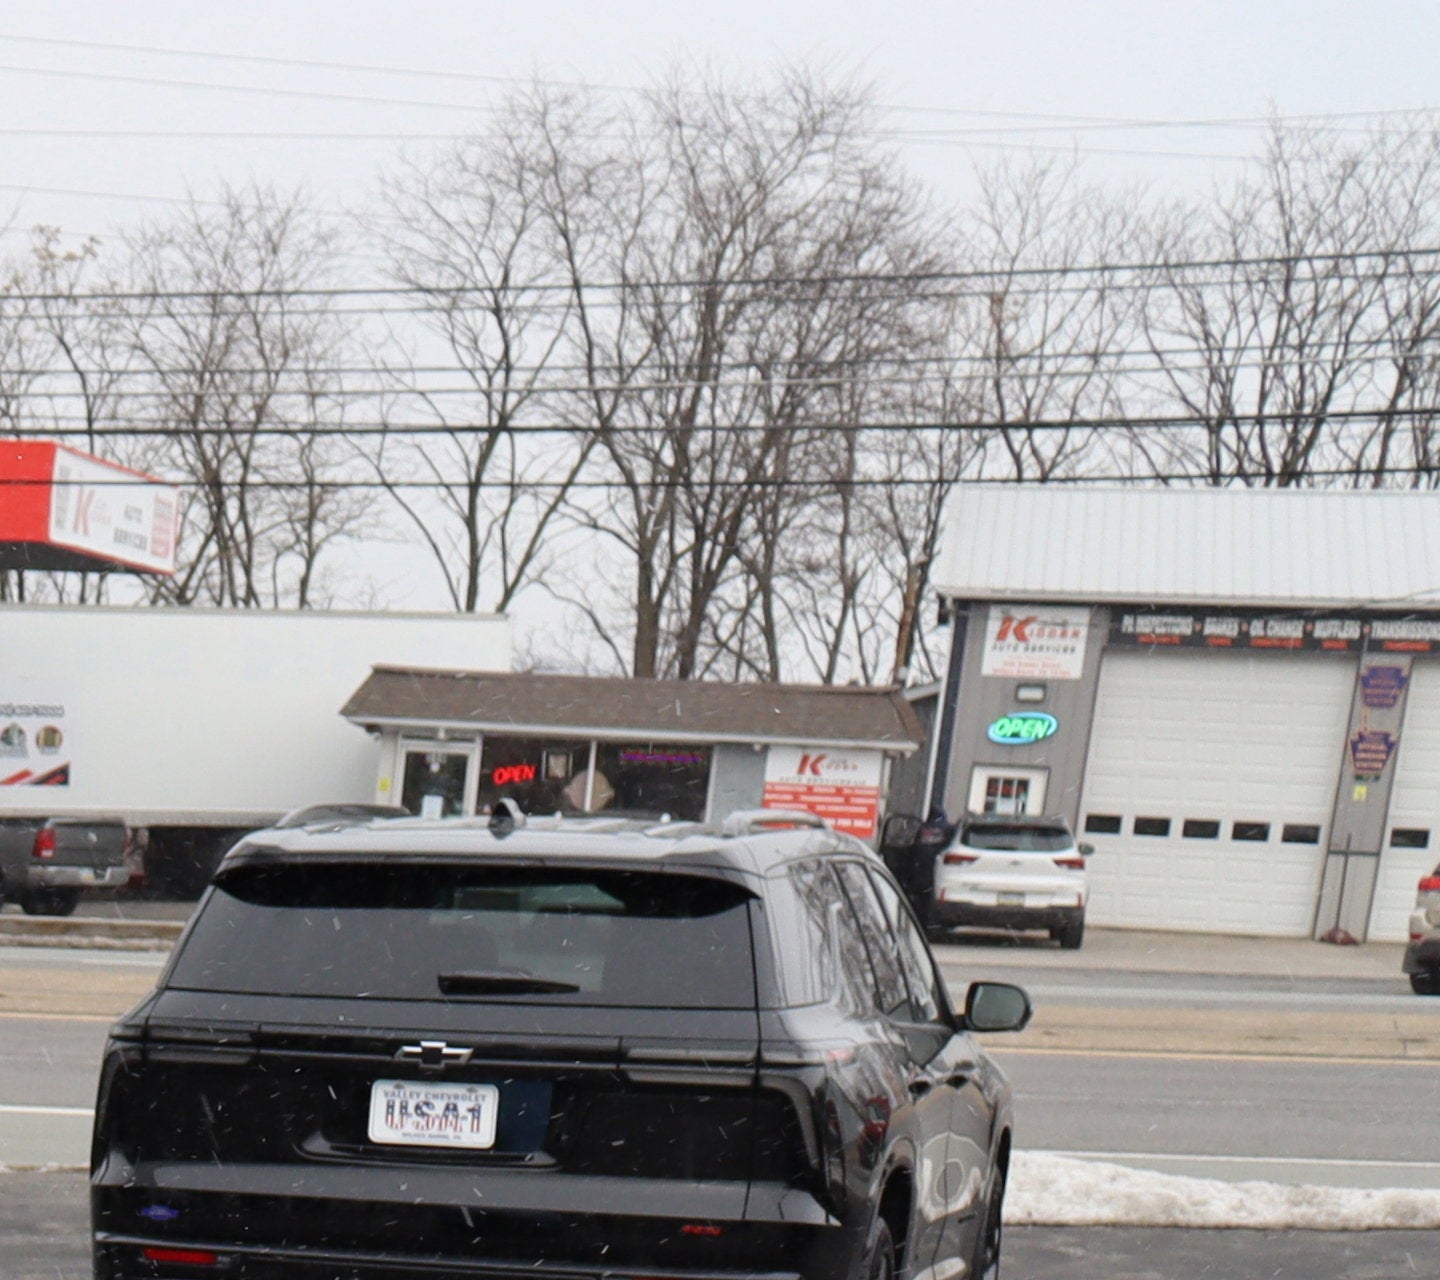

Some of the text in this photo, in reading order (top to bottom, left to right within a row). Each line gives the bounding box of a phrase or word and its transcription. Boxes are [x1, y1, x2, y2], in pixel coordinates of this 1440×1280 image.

[995, 717, 1050, 739] OPEN
[493, 764, 537, 785] OPEN
[384, 1090, 487, 1103] VALLEY CHEVROLET
